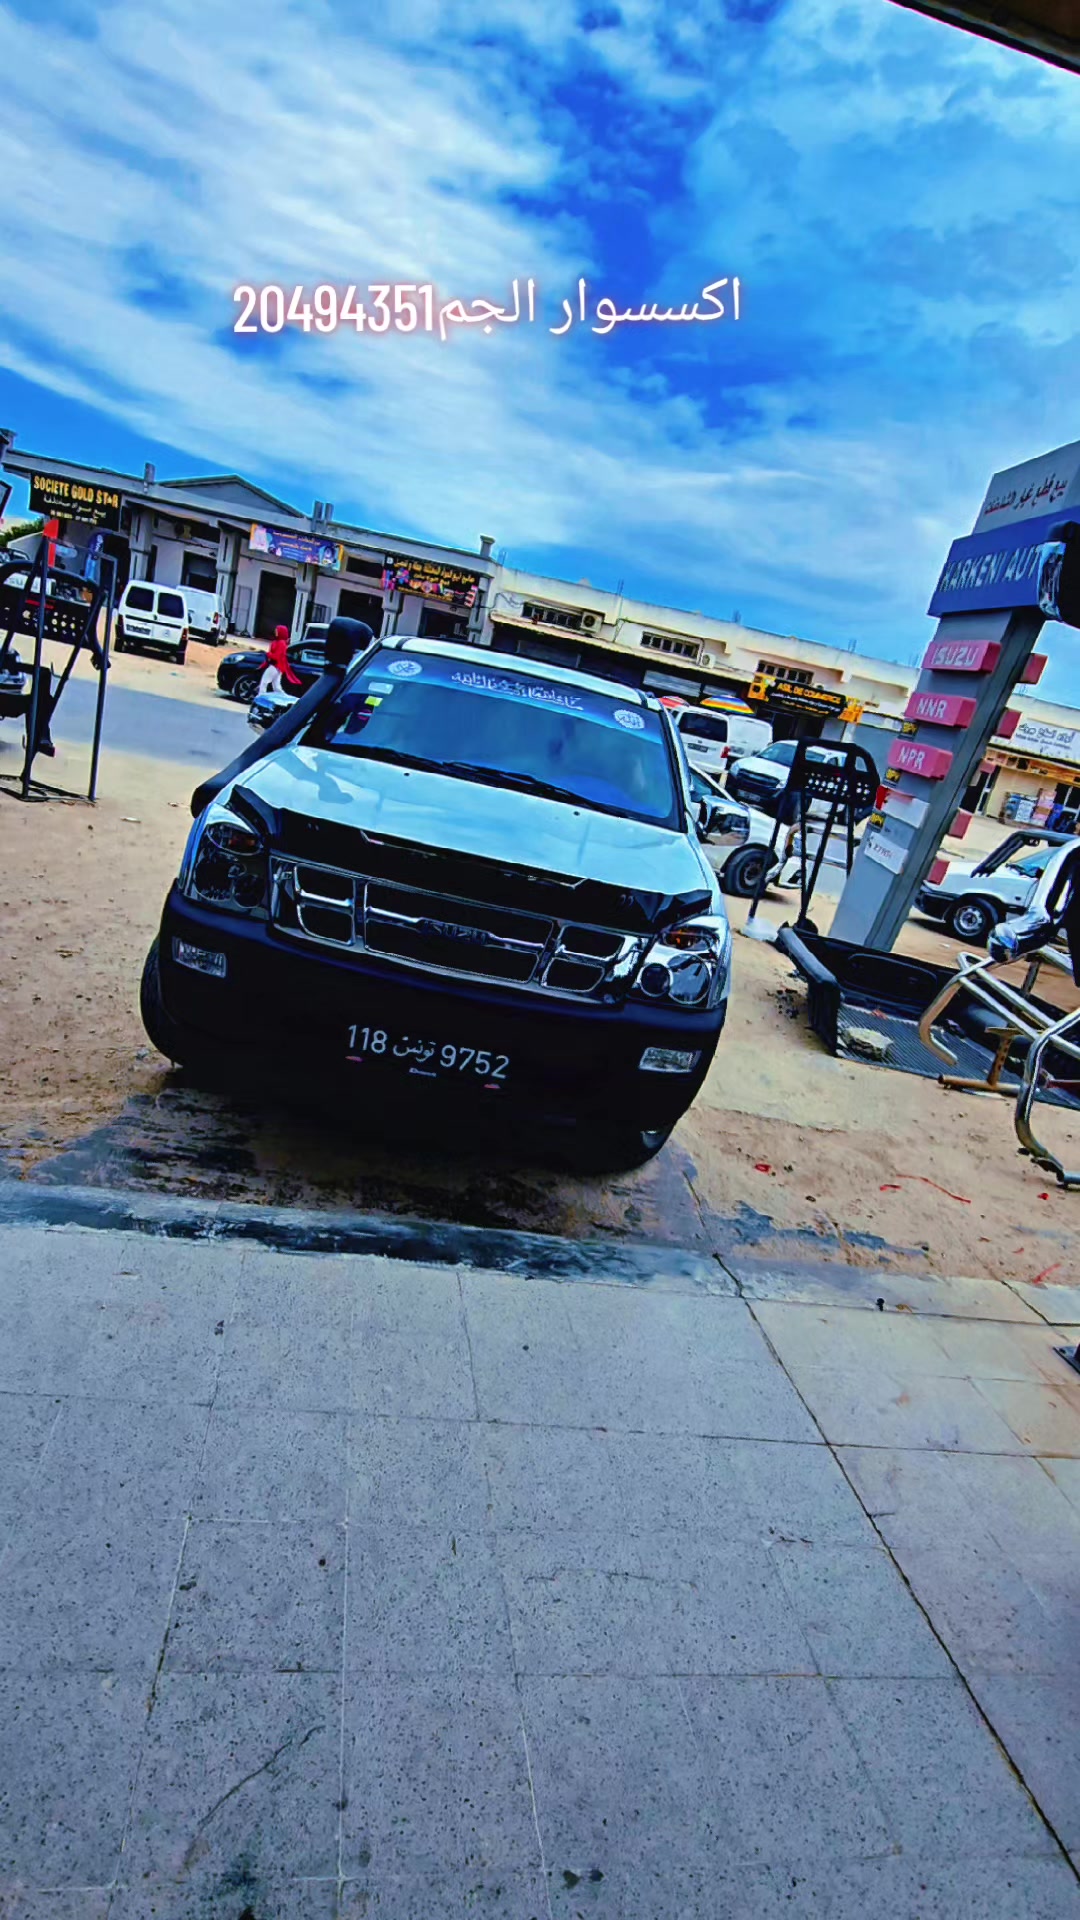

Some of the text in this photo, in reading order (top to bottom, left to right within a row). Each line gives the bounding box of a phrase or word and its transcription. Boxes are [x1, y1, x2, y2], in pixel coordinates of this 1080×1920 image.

[34, 475, 70, 497] SOCIETE
[71, 484, 94, 503] GOLD
[1002, 544, 1043, 582] AUT
[931, 646, 979, 667] ISUZU
[916, 697, 948, 719] NNR
[898, 746, 926, 771] NPR
[421, 919, 488, 945] ISUZU
[348, 1024, 510, 1079] 118 تونس 9752
